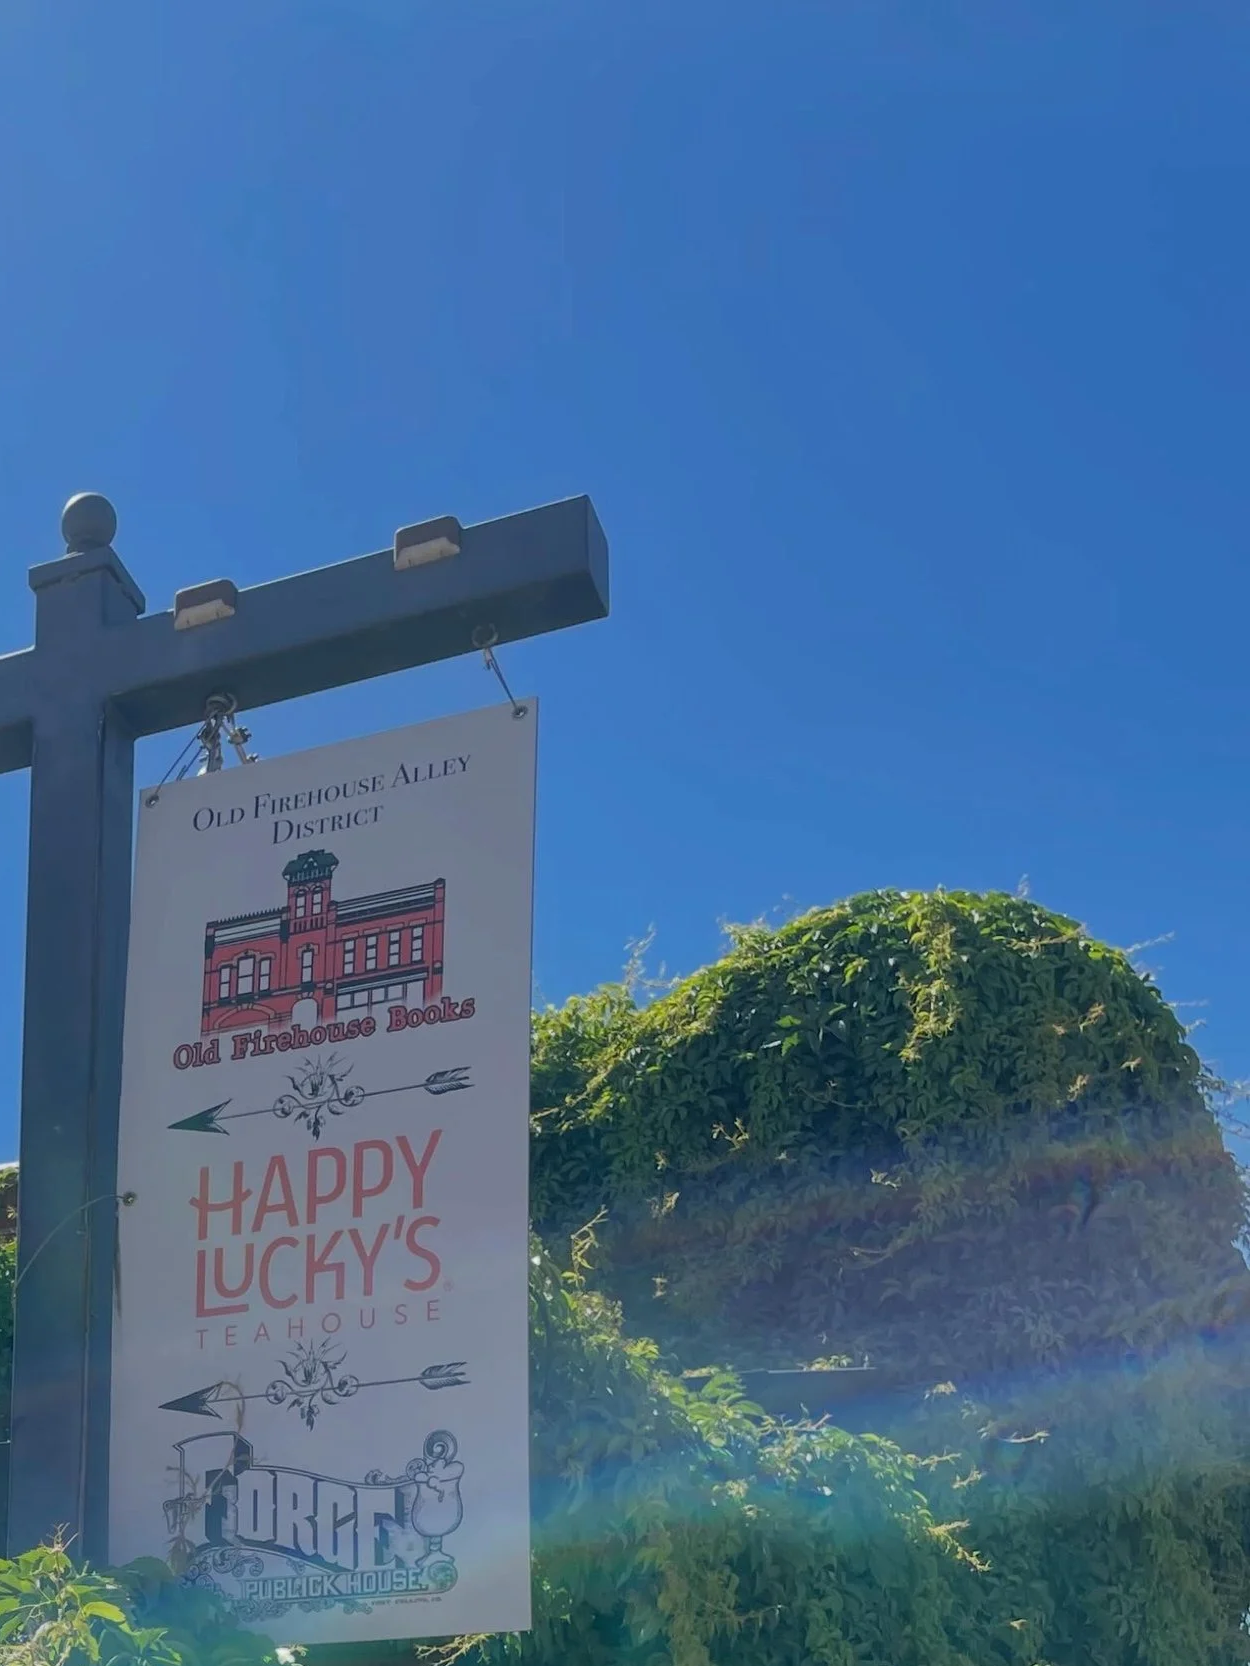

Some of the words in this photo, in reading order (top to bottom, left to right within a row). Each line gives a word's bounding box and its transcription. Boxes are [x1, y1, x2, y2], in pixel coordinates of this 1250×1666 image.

[192, 806, 245, 832] OLD
[252, 773, 385, 820] FIREHOUSE
[390, 754, 472, 790] ALLEY
[271, 804, 384, 845] DISTRICT
[173, 1036, 220, 1070] Old
[231, 1013, 376, 1061] Firehouse
[387, 996, 475, 1033] Books
[188, 1128, 443, 1241] HAPPY
[194, 1214, 442, 1318] LUCKY'S
[195, 1299, 441, 1350] TEAHOUSE
[245, 1572, 342, 1600] PUBLICK
